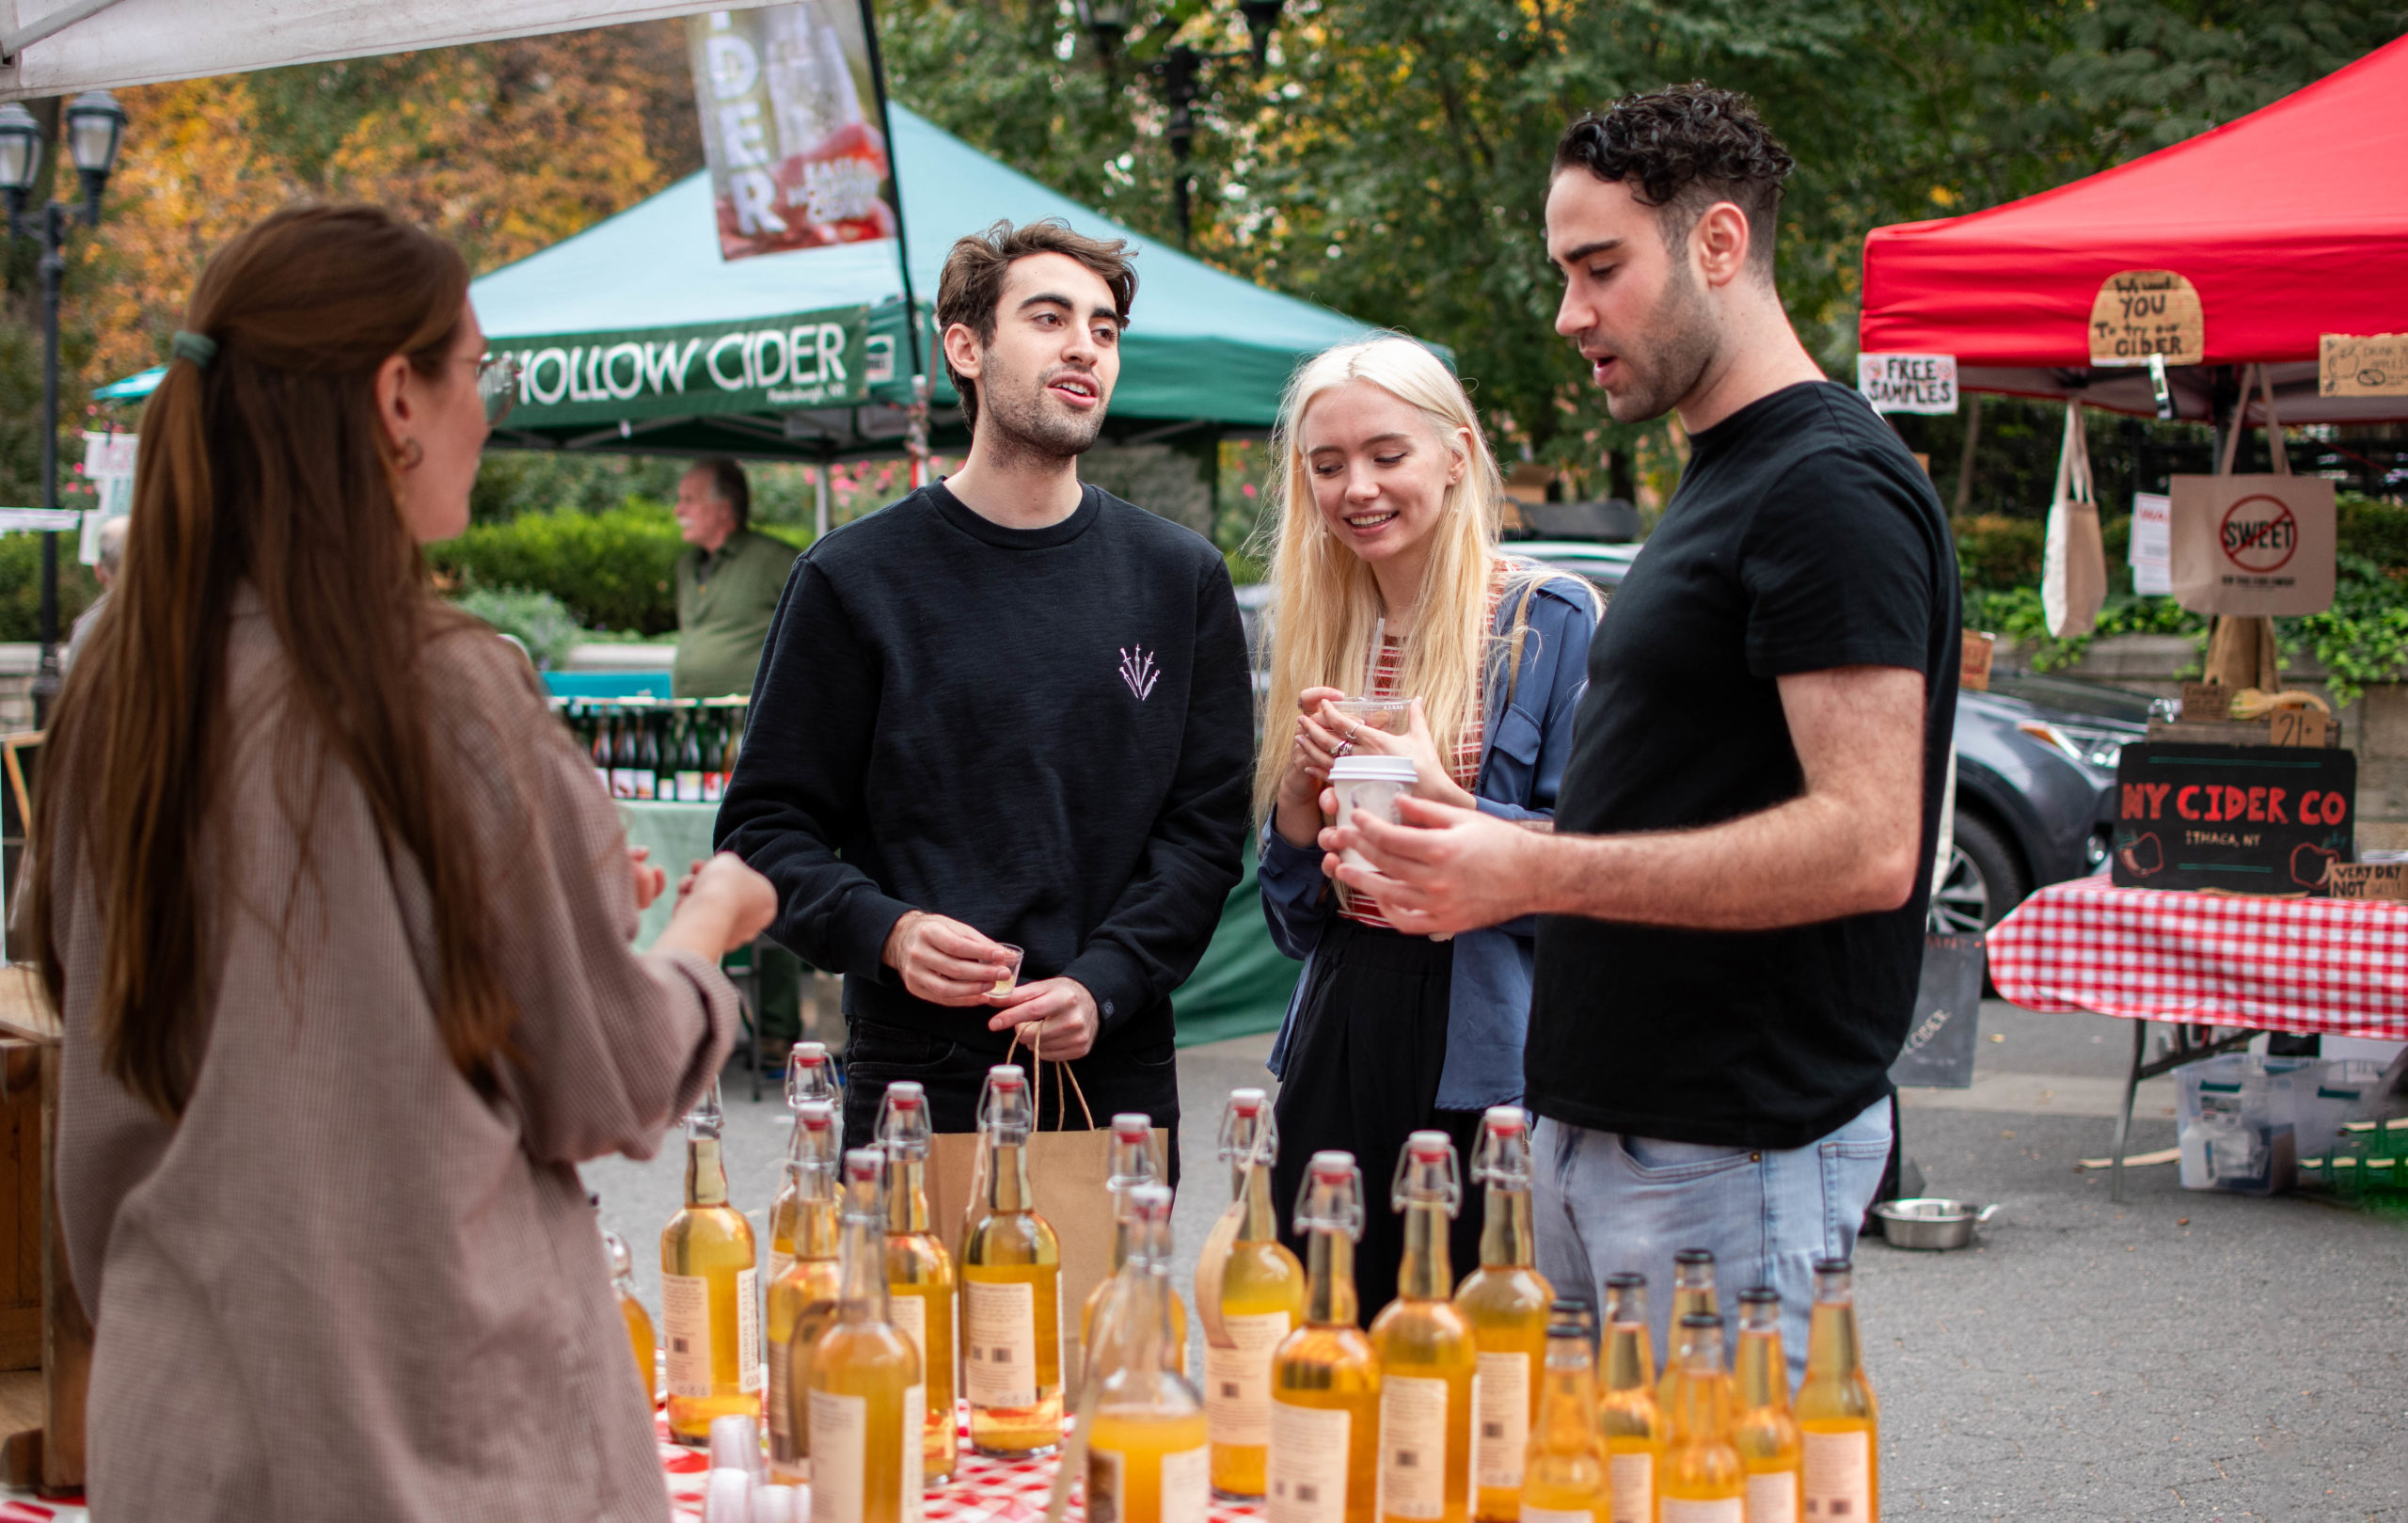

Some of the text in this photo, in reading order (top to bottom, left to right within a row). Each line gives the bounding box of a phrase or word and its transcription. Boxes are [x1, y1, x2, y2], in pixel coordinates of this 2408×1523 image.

[2119, 293, 2166, 319] YOU
[705, 323, 848, 391] CIDER
[1887, 358, 1937, 380] FREE
[1868, 380, 1951, 405] SAMPLES
[2226, 520, 2293, 548] SWEET
[2278, 713, 2312, 747] 21+
[2121, 783, 2346, 826] NY CIDER CO
[2242, 833, 2261, 847] NY
[2336, 865, 2371, 880] VERY
[2333, 880, 2367, 897] NOT
